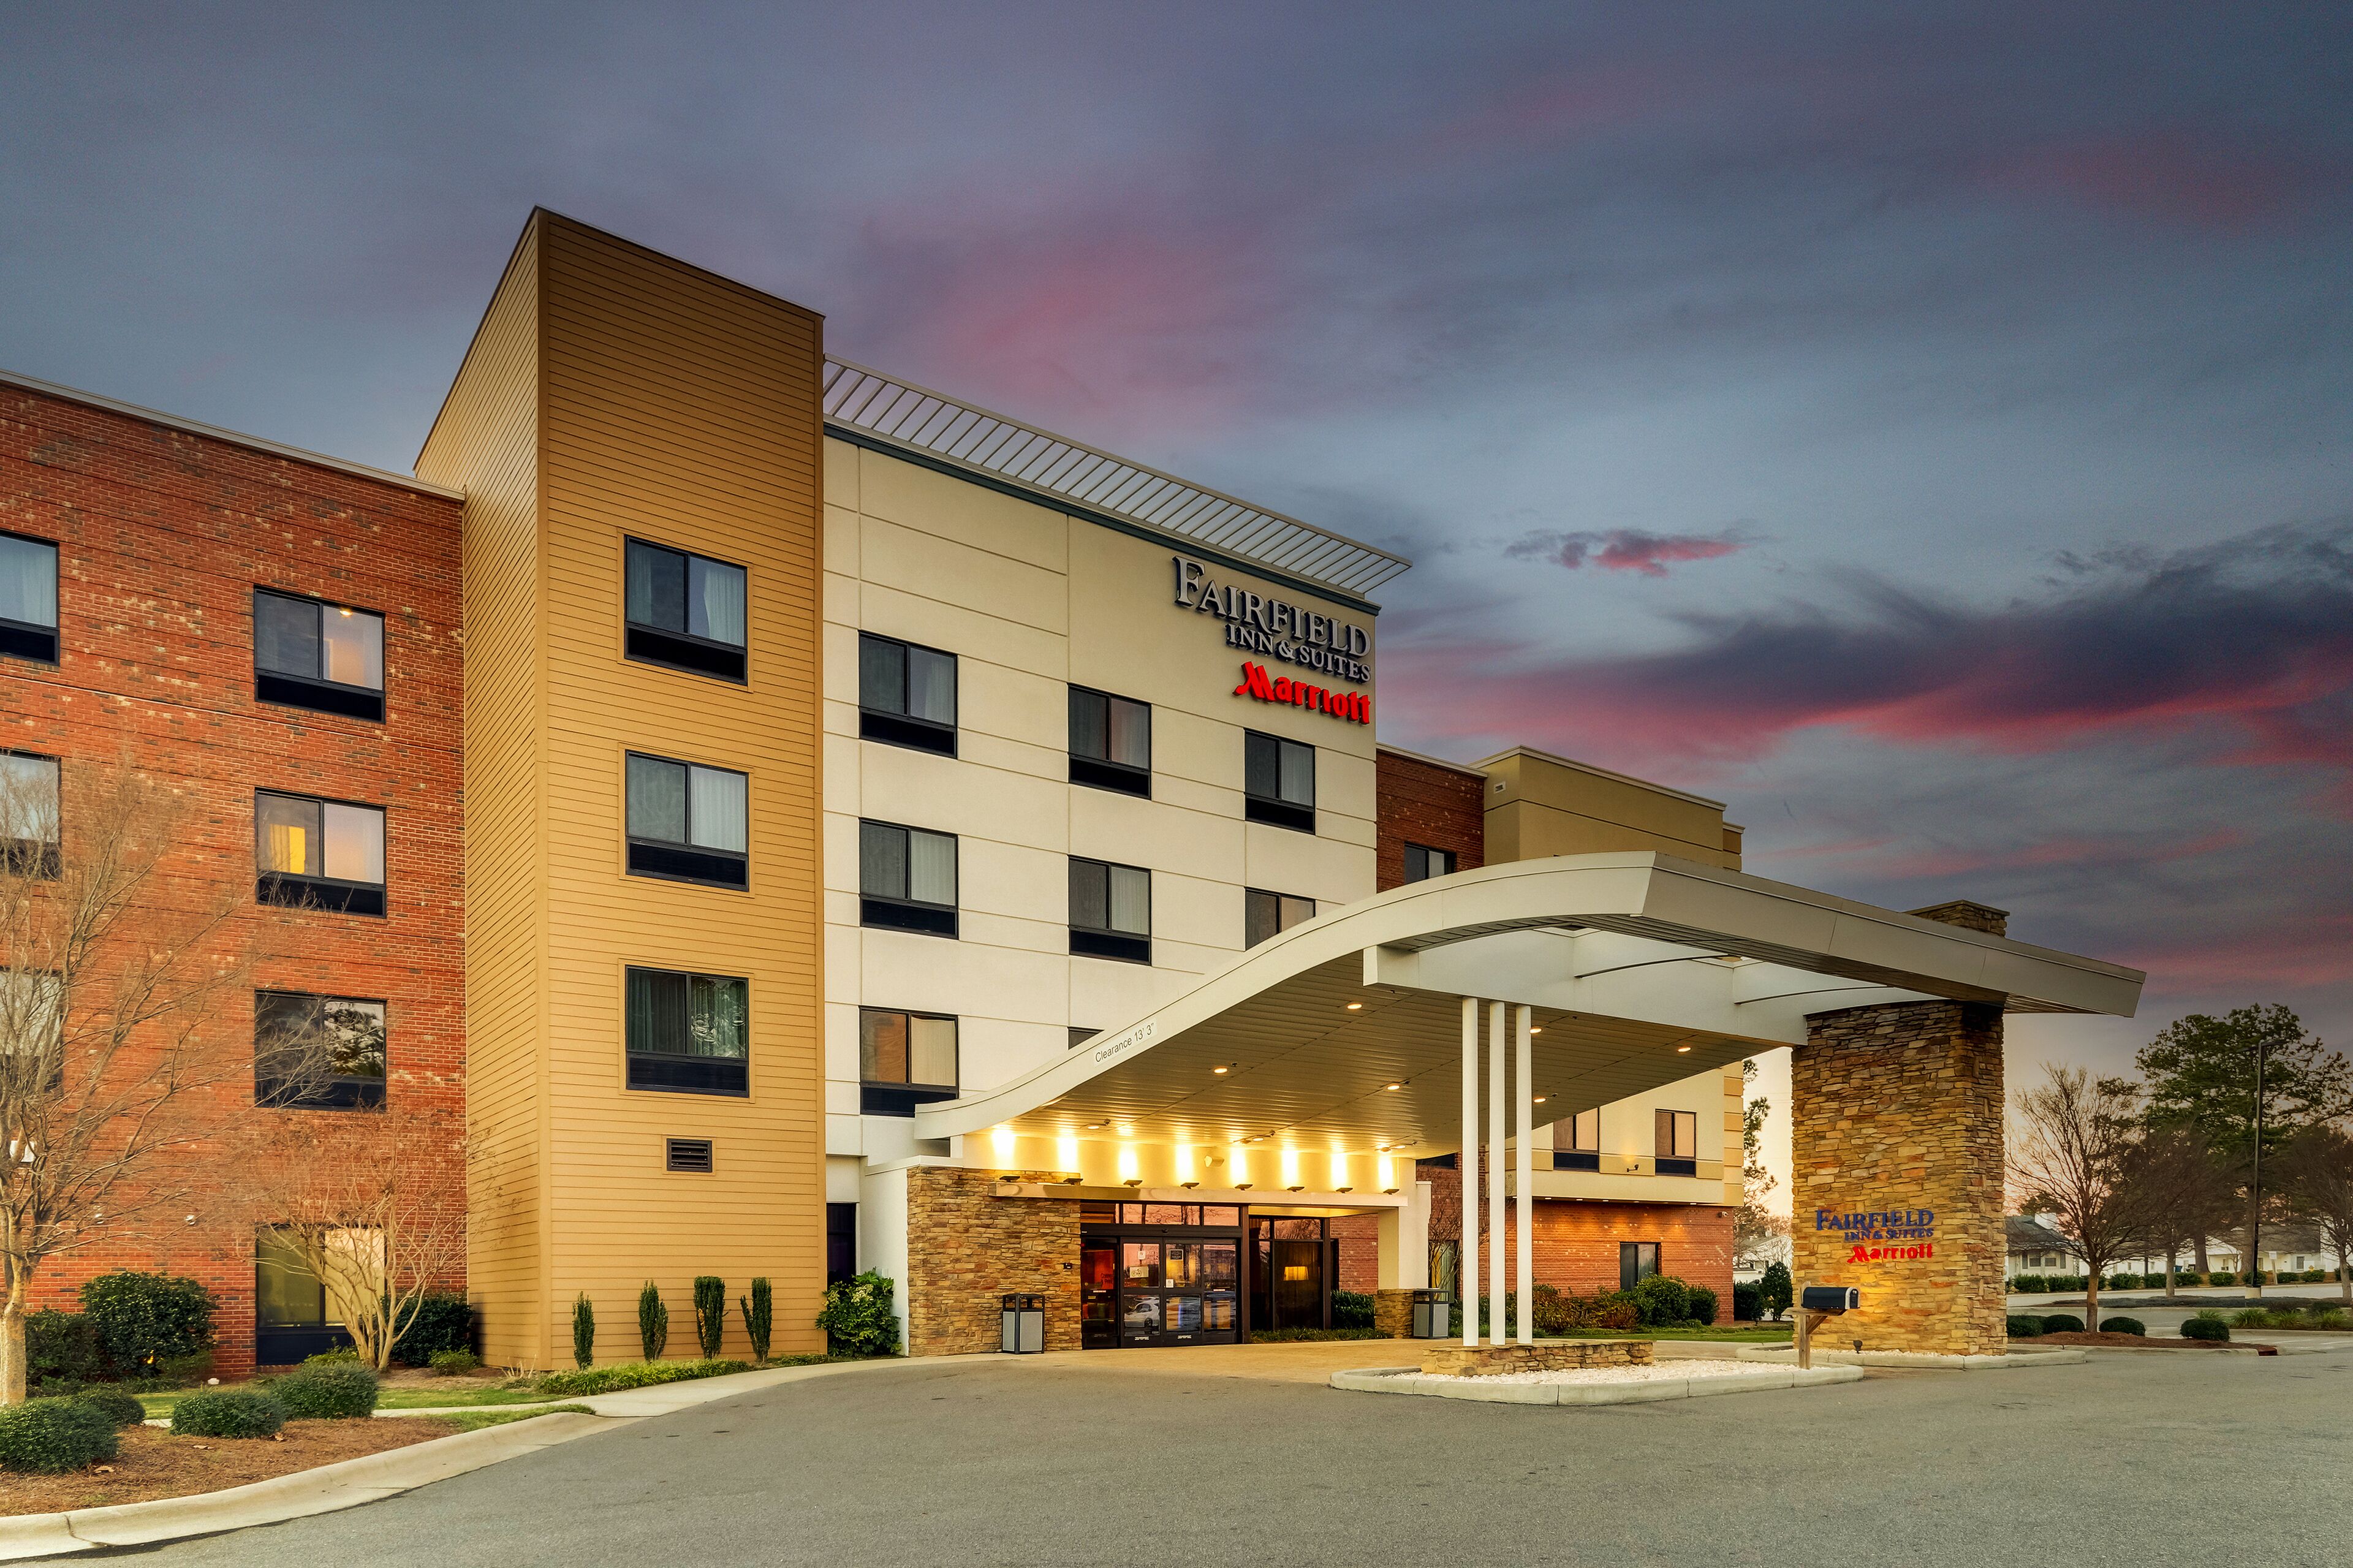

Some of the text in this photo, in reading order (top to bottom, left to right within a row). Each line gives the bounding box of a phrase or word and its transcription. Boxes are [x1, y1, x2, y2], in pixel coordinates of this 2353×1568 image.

[1172, 556, 1372, 657] FAIRFIELD
[1226, 623, 1371, 684] INN & SUITES
[1232, 661, 1371, 725] Marriott
[1096, 1037, 1132, 1062] Clearance
[1816, 1209, 1934, 1231] FAIRFIELD
[1844, 1227, 1934, 1241] INN & SUITES
[1847, 1243, 1933, 1263] Marriott
